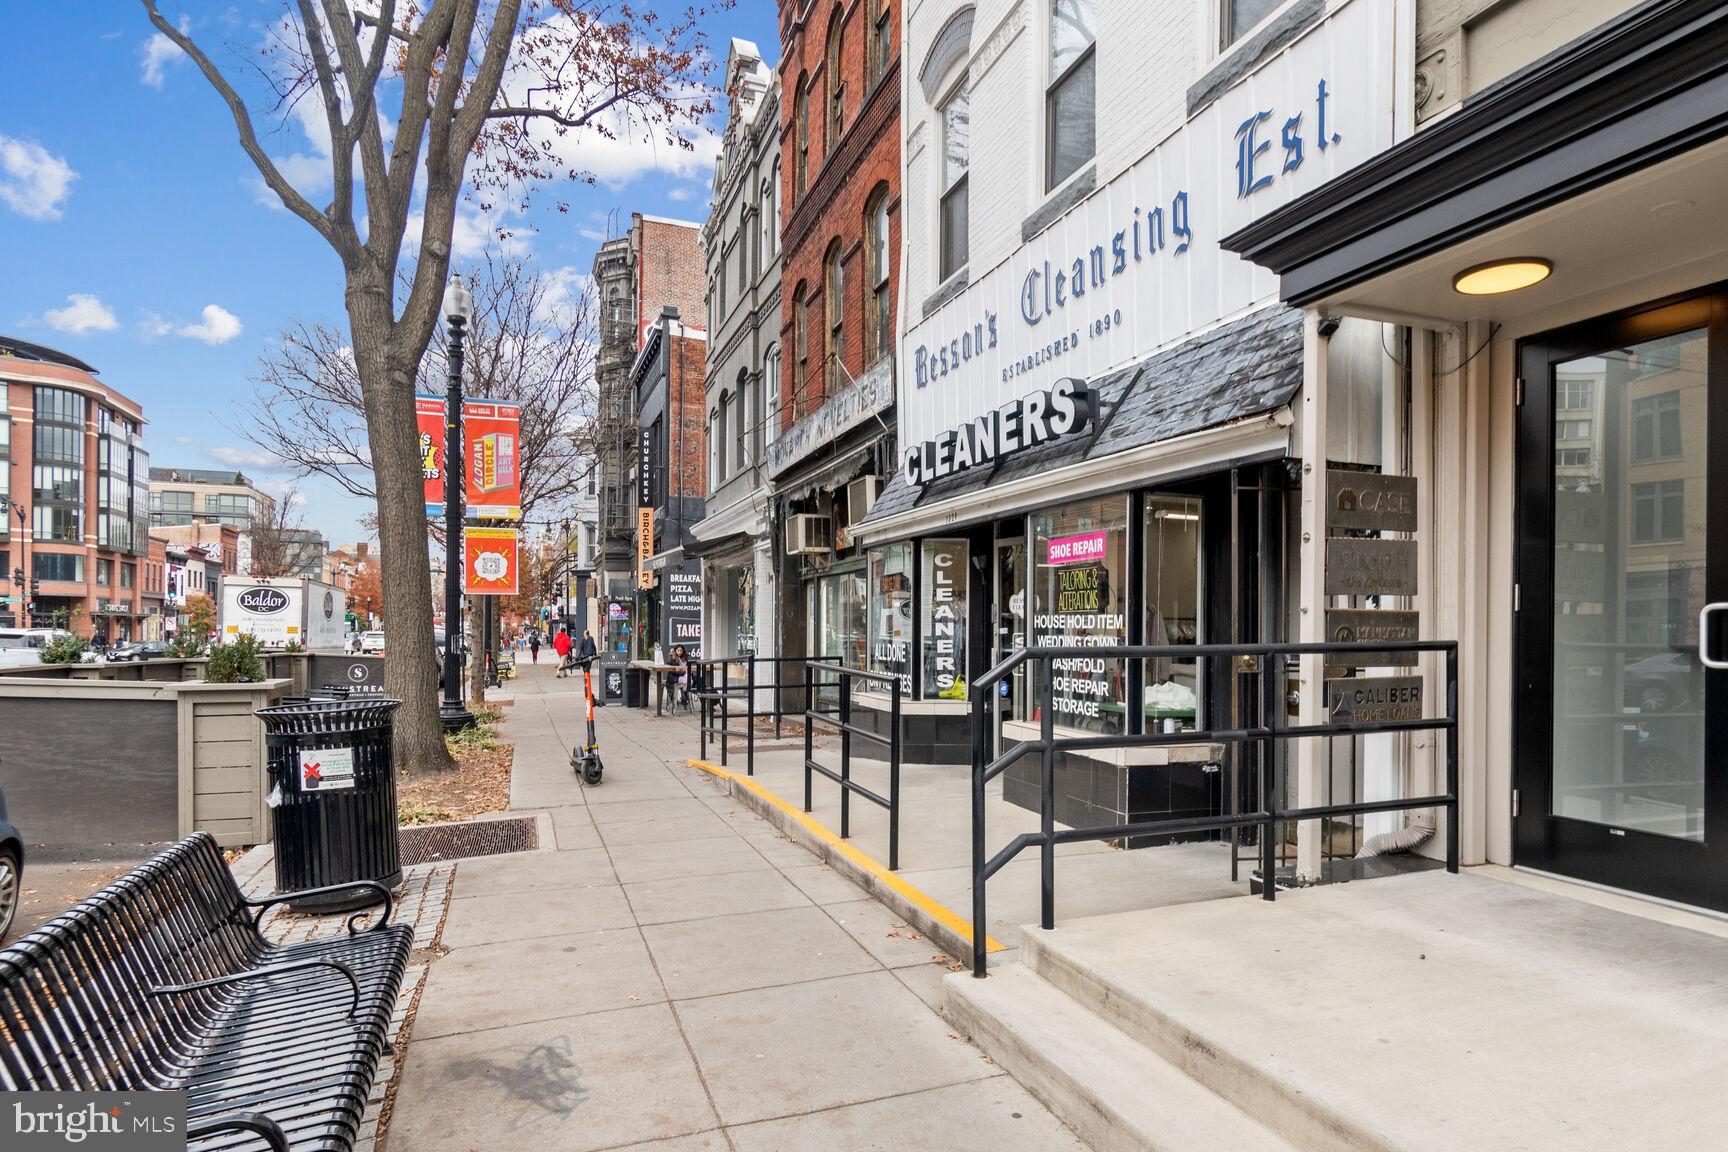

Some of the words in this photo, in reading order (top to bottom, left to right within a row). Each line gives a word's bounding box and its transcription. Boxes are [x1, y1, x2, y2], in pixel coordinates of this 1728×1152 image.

[914, 309, 998, 390] Besson's
[1020, 190, 1193, 326] Cleansing
[1235, 78, 1342, 200] Est.
[1001, 329, 1080, 383] ESTABLISHED
[1088, 308, 1122, 339] 1890
[904, 377, 1080, 487] CLEANERS
[474, 443, 484, 486] LOGAN
[485, 443, 494, 485] CIRCLE
[1050, 543, 1071, 559] SHOE
[1072, 538, 1103, 556] REPAIR
[670, 574, 701, 583] BREAKFA
[1092, 568, 1099, 588] &
[243, 591, 284, 607] Baldor
[670, 585, 693, 593] PIZZA
[670, 595, 687, 603] LATE
[1058, 590, 1099, 611] ALTERATIONS
[934, 553, 955, 688] CLEANERS
[1034, 615, 1066, 629] HOUSE
[1067, 615, 1095, 629] HOLD
[1097, 614, 1123, 629] ITEM
[1037, 634, 1082, 647] WEDDING
[1084, 635, 1118, 647] GOWN
[875, 643, 886, 660] ALL
[887, 643, 906, 662] DONE
[1072, 679, 1109, 697] REPAIR
[1354, 687, 1420, 704] CALIBER
[1053, 696, 1099, 717] STORAGE
